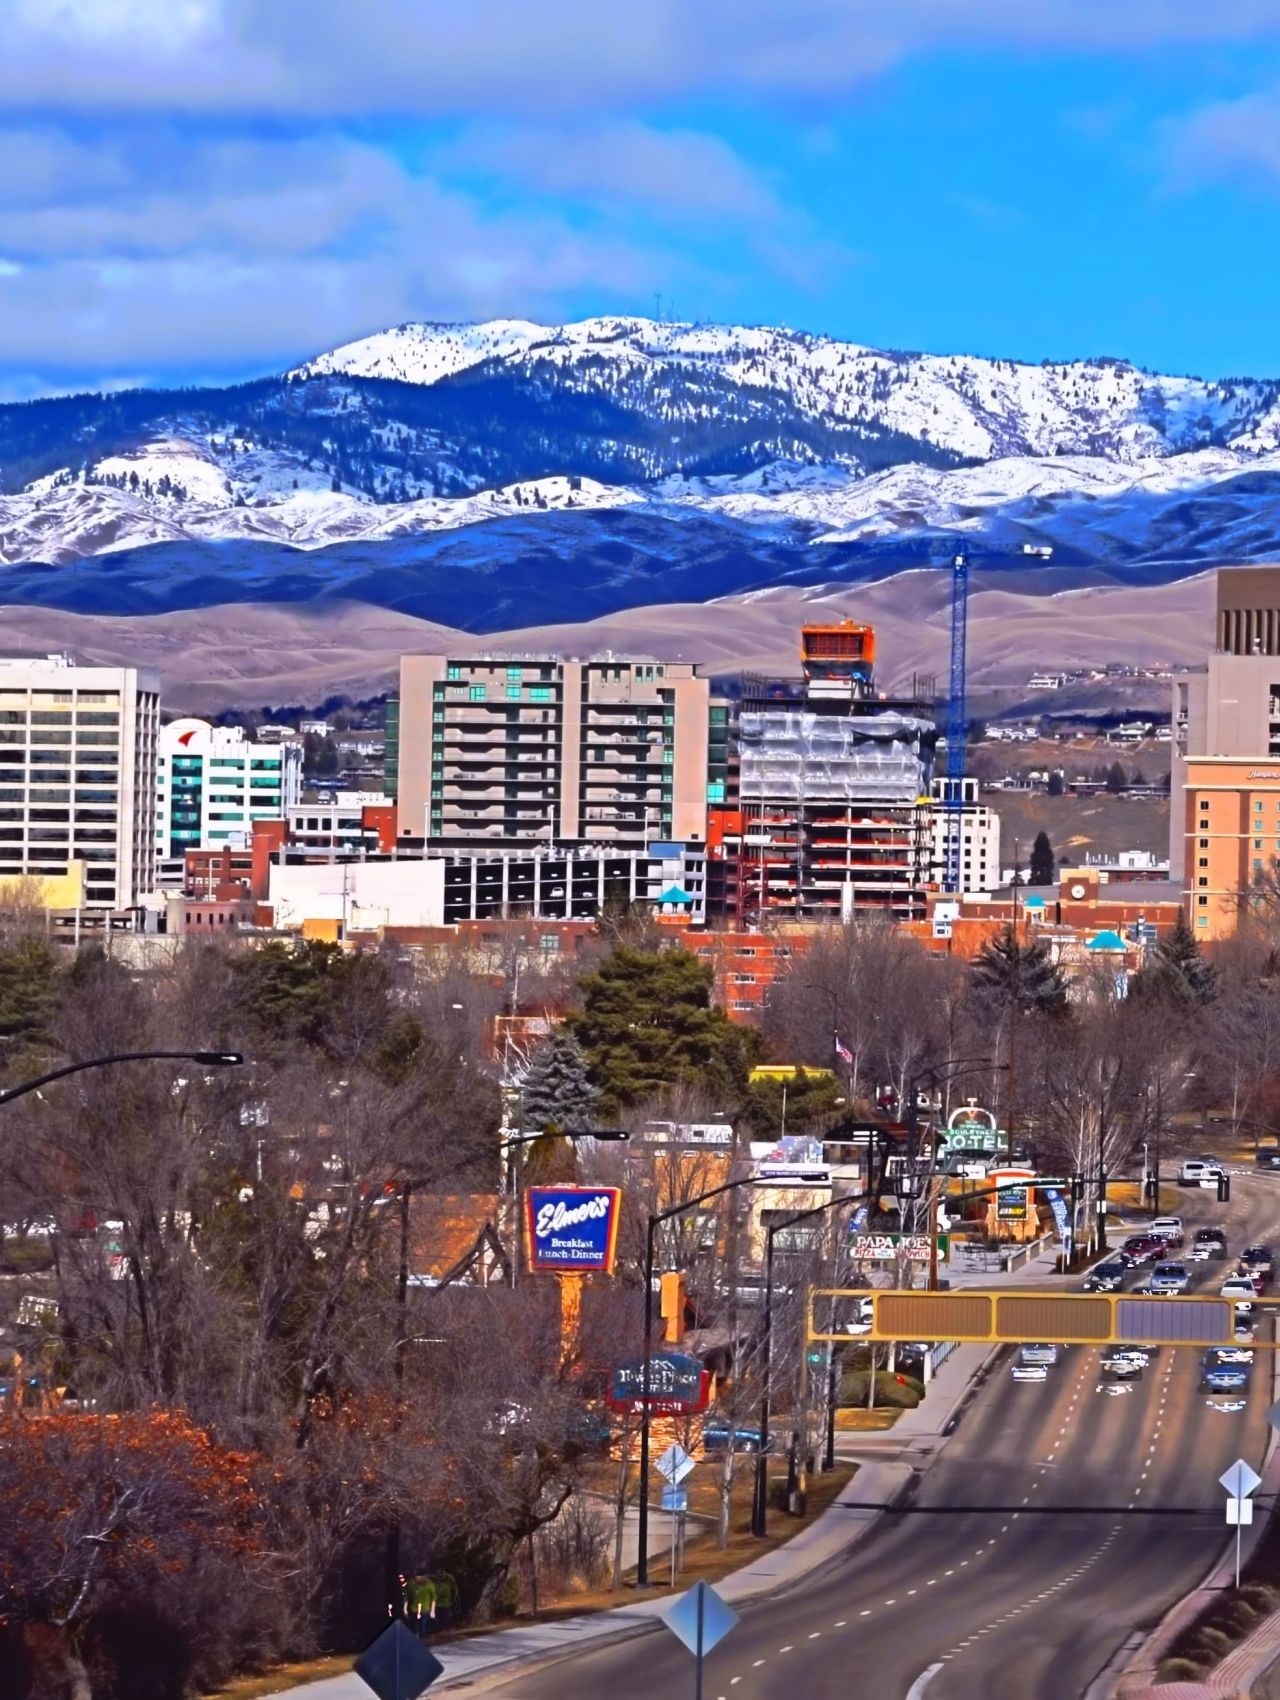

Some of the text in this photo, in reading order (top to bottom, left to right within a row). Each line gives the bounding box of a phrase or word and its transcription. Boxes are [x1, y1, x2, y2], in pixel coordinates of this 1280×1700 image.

[536, 1196, 610, 1238] Elmer's
[551, 1238, 594, 1248] Breakfast
[856, 1236, 894, 1248] PAPA
